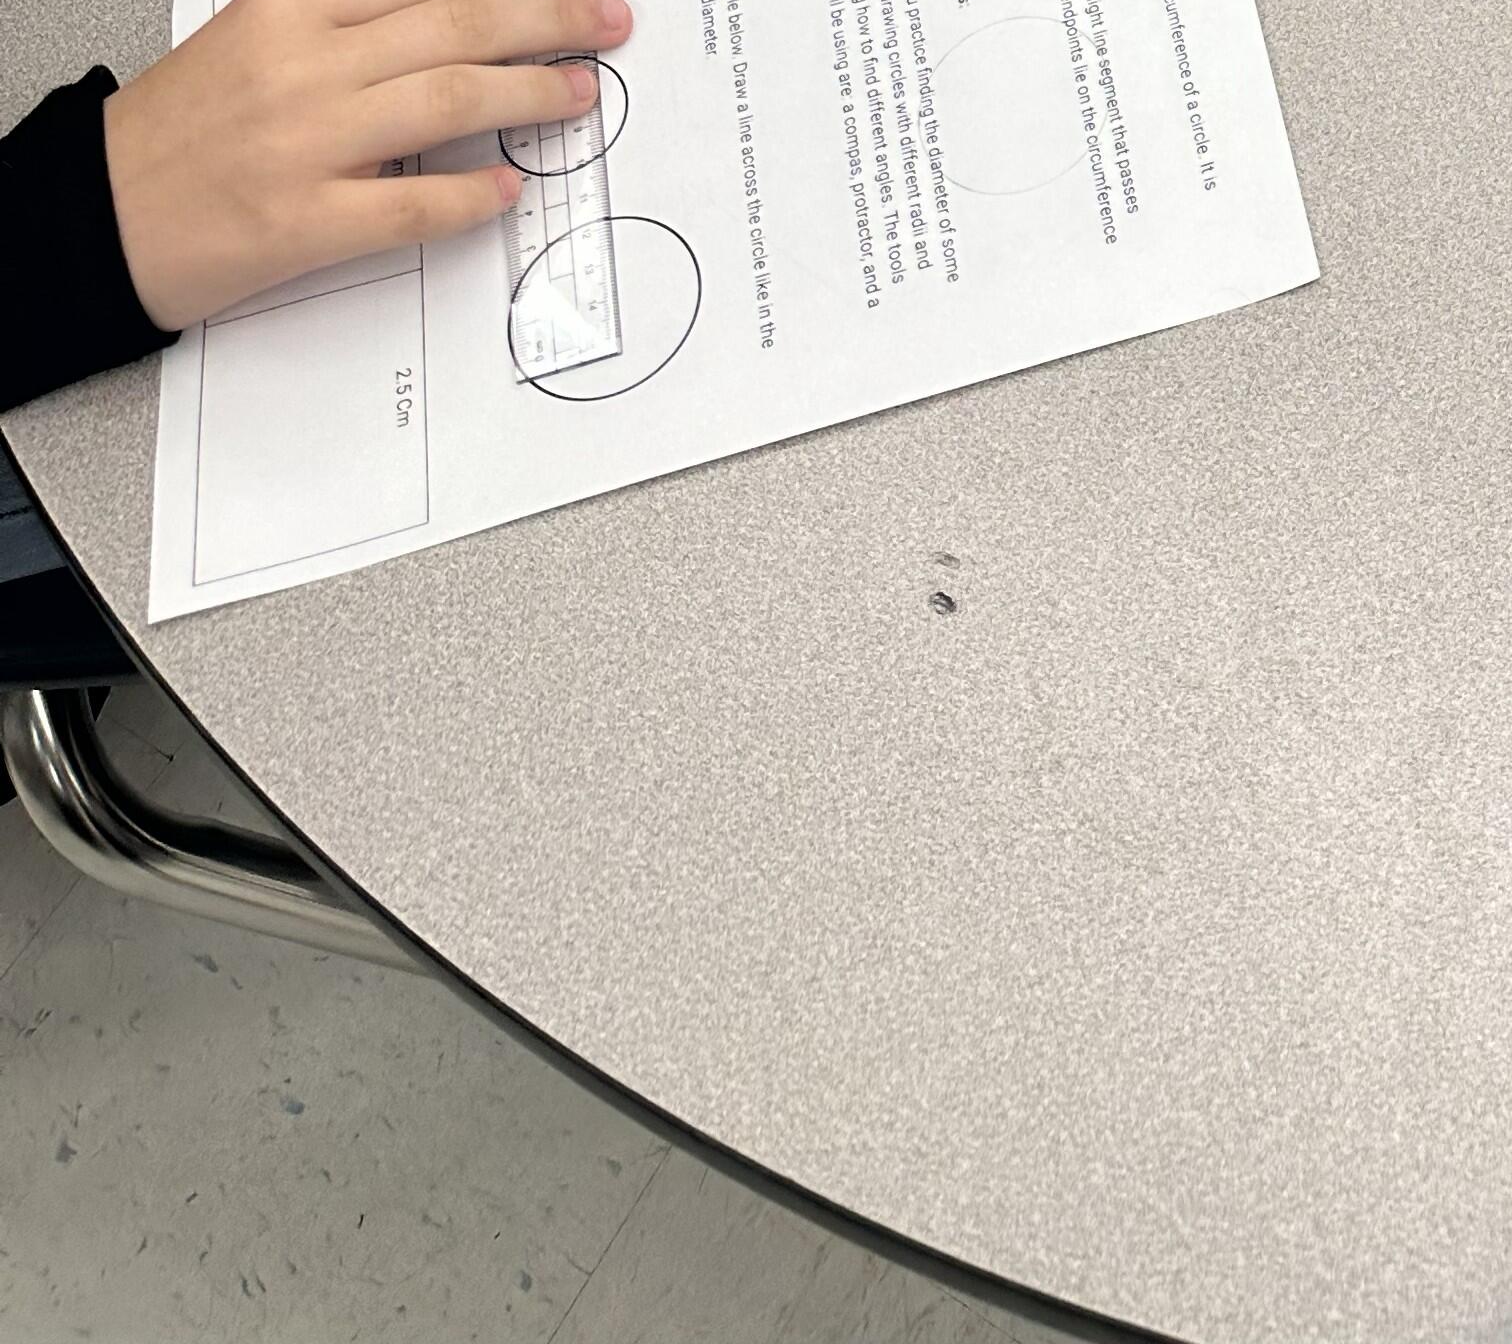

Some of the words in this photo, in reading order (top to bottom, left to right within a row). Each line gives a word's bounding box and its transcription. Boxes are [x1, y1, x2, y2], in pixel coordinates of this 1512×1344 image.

[829, 7, 846, 28] be
[855, 4, 872, 36] how
[832, 29, 850, 71] using
[859, 38, 875, 55] to
[904, 7, 928, 66] practice
[1092, 29, 1109, 57] line
[732, 61, 749, 100] Draw
[862, 56, 882, 86] find
[887, 51, 908, 100] circles
[1072, 63, 1089, 83] lie
[916, 66, 936, 119] finding
[1076, 85, 1091, 105] on
[1097, 59, 1124, 124] segment
[1182, 81, 1201, 97] of
[736, 102, 749, 114] a
[842, 103, 855, 114] a
[866, 88, 889, 152] different
[895, 100, 914, 134] with
[1080, 105, 1103, 132] the
[1186, 100, 1199, 111] a
[737, 114, 755, 144] line
[924, 119, 941, 145] the
[1111, 124, 1131, 157] that
[843, 116, 863, 181] compas,
[740, 145, 758, 197] across
[899, 136, 922, 201] different
[927, 147, 953, 214] diameter
[1199, 160, 1215, 175] It
[1086, 134, 1118, 245] circumference
[1113, 158, 1139, 214] passes
[1202, 176, 1217, 192] is
[746, 198, 764, 225] the
[848, 182, 874, 262] protractor,
[882, 209, 901, 242] The
[909, 202, 929, 238] radii
[938, 218, 957, 234] of
[749, 227, 770, 271] circle
[887, 242, 908, 285] tools
[913, 240, 935, 271] and
[941, 238, 960, 284] some
[754, 272, 772, 302] like
[862, 264, 883, 295] and
[757, 302, 774, 320] in
[866, 297, 880, 309] a
[759, 321, 777, 350] the
[395, 366, 413, 396] 2.5
[395, 397, 414, 429] Cm
